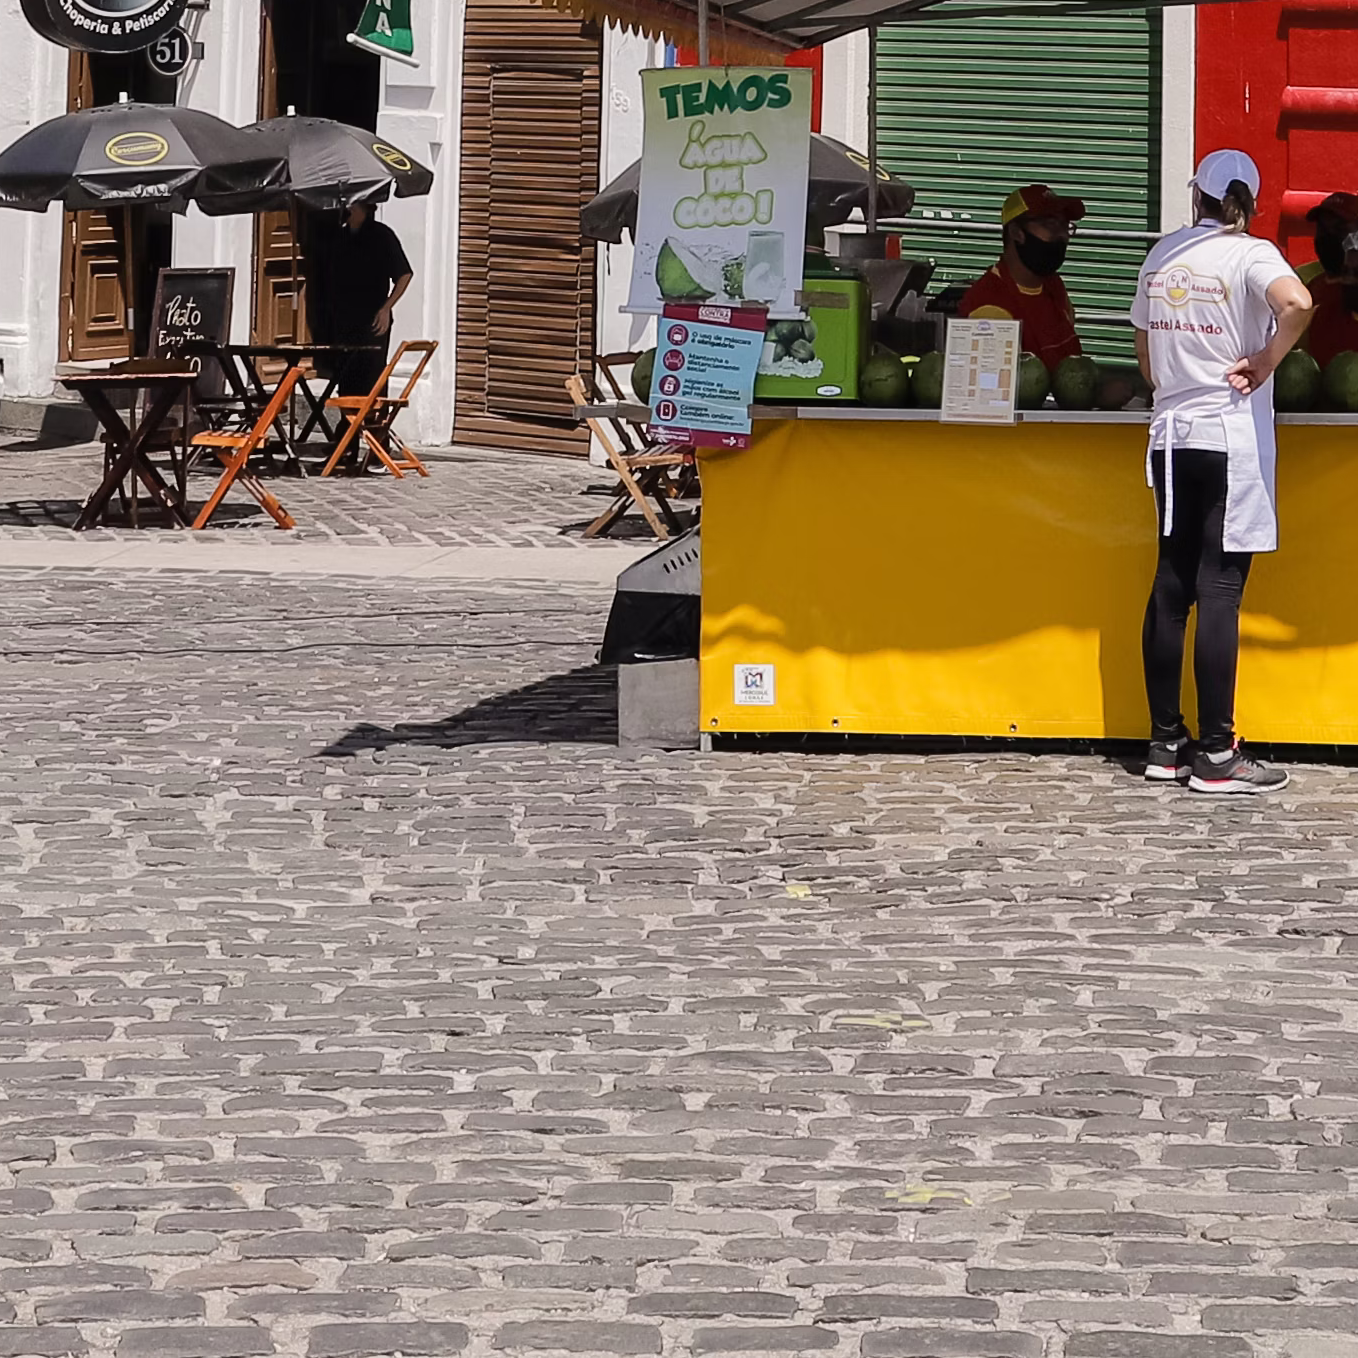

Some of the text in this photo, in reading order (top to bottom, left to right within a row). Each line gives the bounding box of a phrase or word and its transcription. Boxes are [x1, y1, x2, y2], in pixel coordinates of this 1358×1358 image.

[111, 21, 122, 35] &
[155, 37, 184, 64] 51
[658, 73, 792, 120] TEMOS
[679, 120, 768, 169] ÁGUA
[704, 165, 744, 196] DE
[673, 189, 774, 229] COCO!
[1191, 284, 1224, 295] Assado
[1150, 319, 1223, 335] astel Assado
